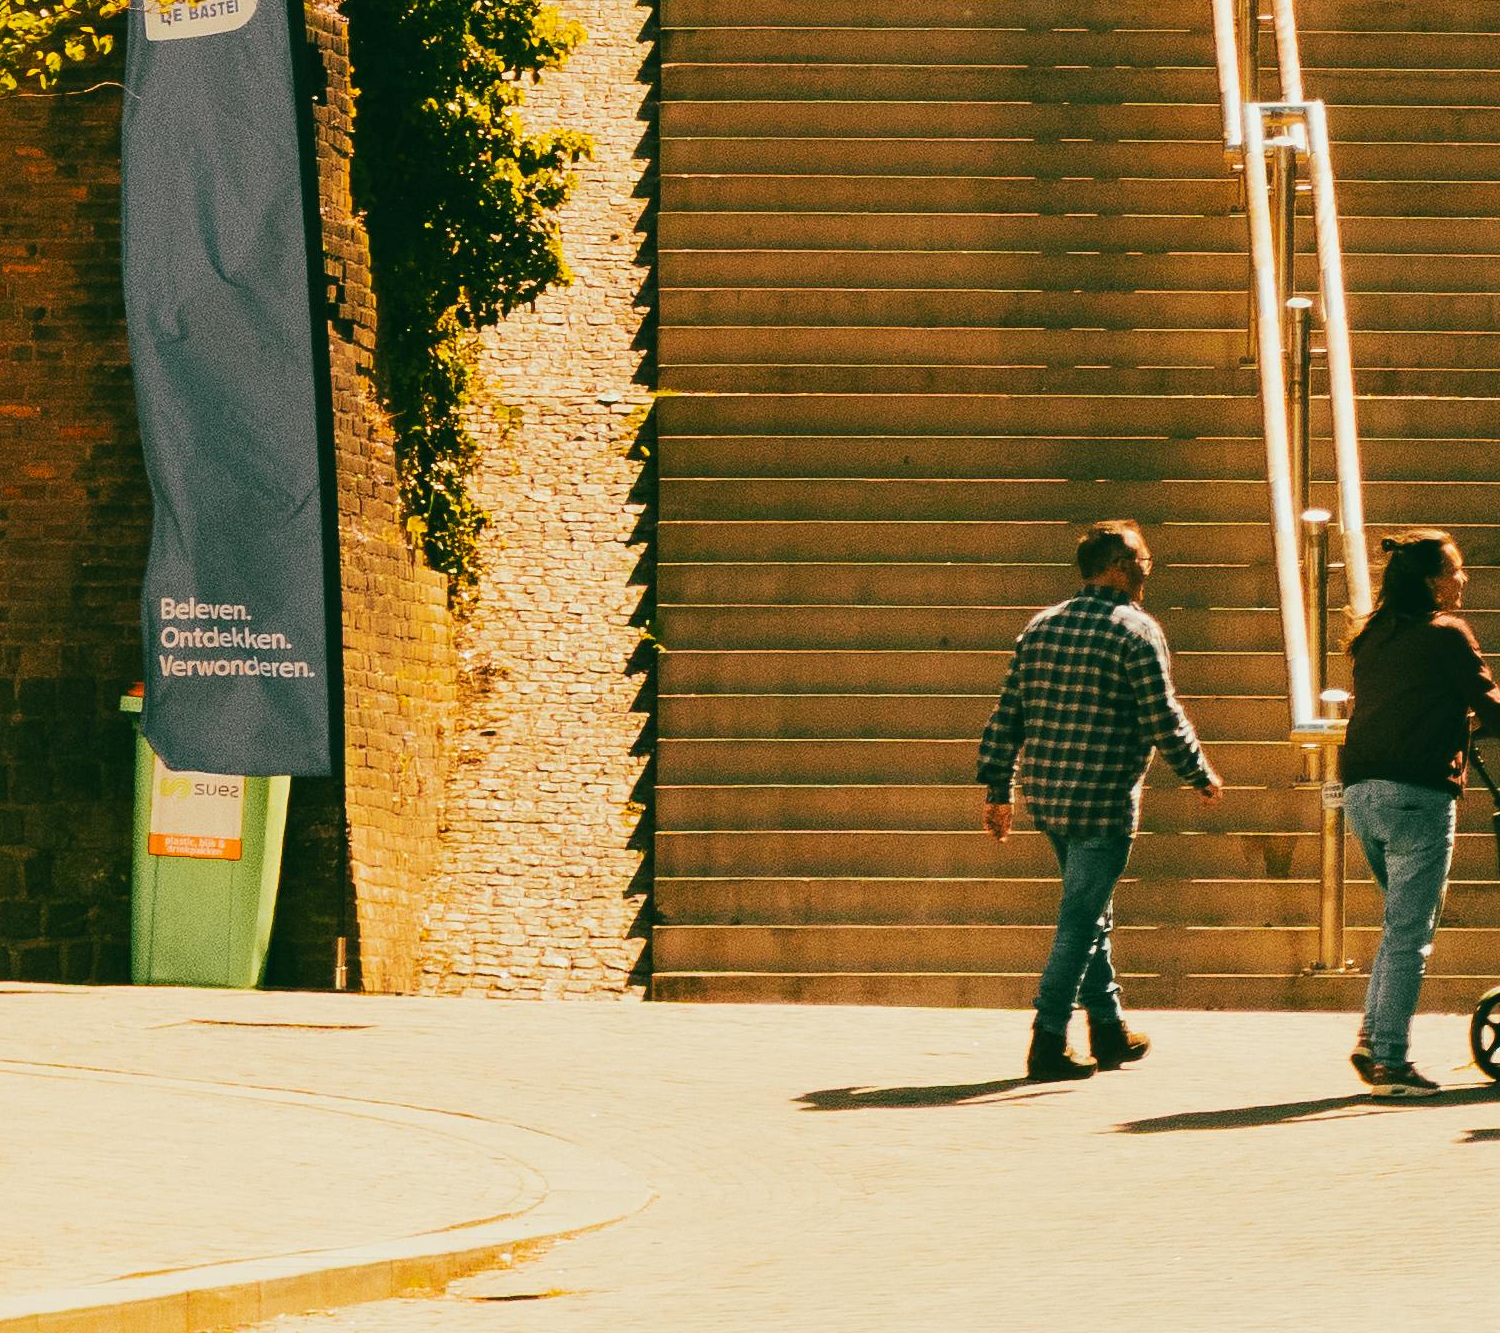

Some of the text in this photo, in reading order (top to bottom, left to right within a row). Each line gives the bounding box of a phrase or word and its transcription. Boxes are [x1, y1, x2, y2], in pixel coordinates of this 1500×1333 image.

[188, 0, 240, 21] BASTEI
[160, 597, 252, 620] Beleven.
[160, 626, 293, 650] Ontdekken.
[159, 654, 316, 678] Verwonderen.
